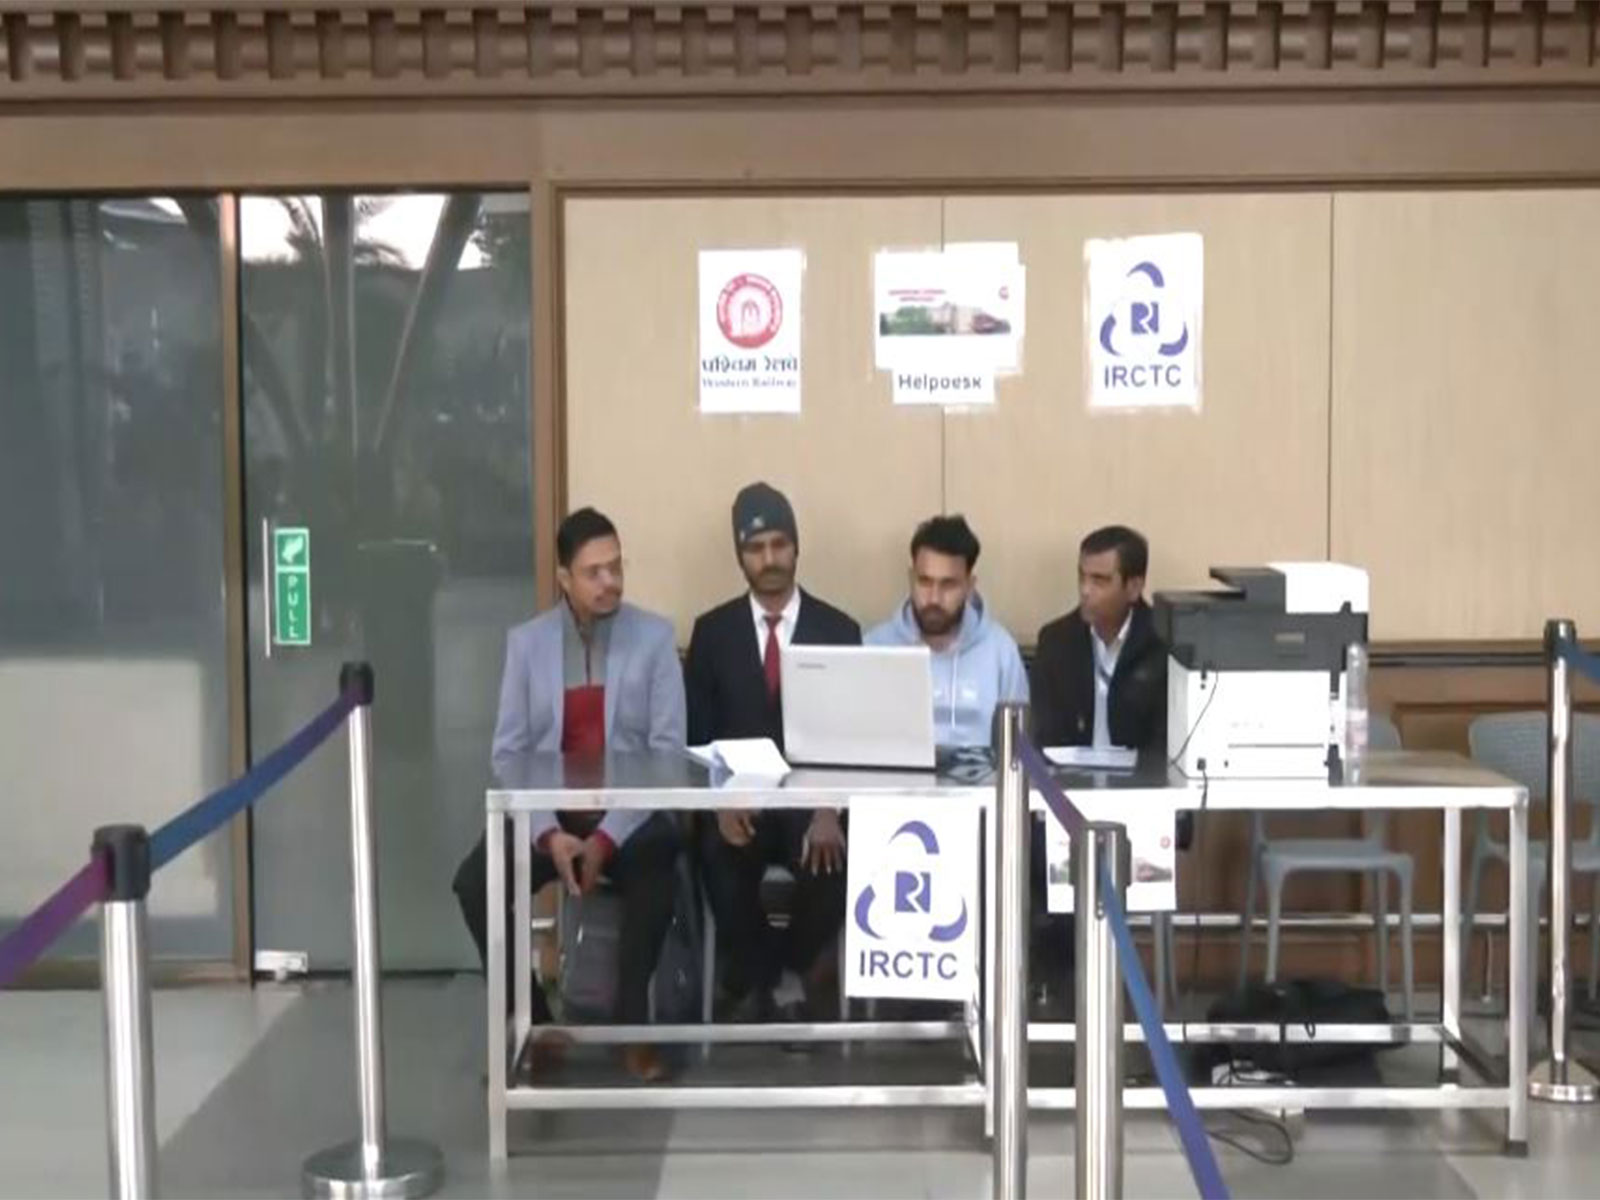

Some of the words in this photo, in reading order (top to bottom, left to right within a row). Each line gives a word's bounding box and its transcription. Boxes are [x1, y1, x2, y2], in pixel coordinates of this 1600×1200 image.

[1104, 364, 1182, 388] IRCTC
[287, 575, 300, 638] PULL
[858, 948, 958, 980] IRCTC
